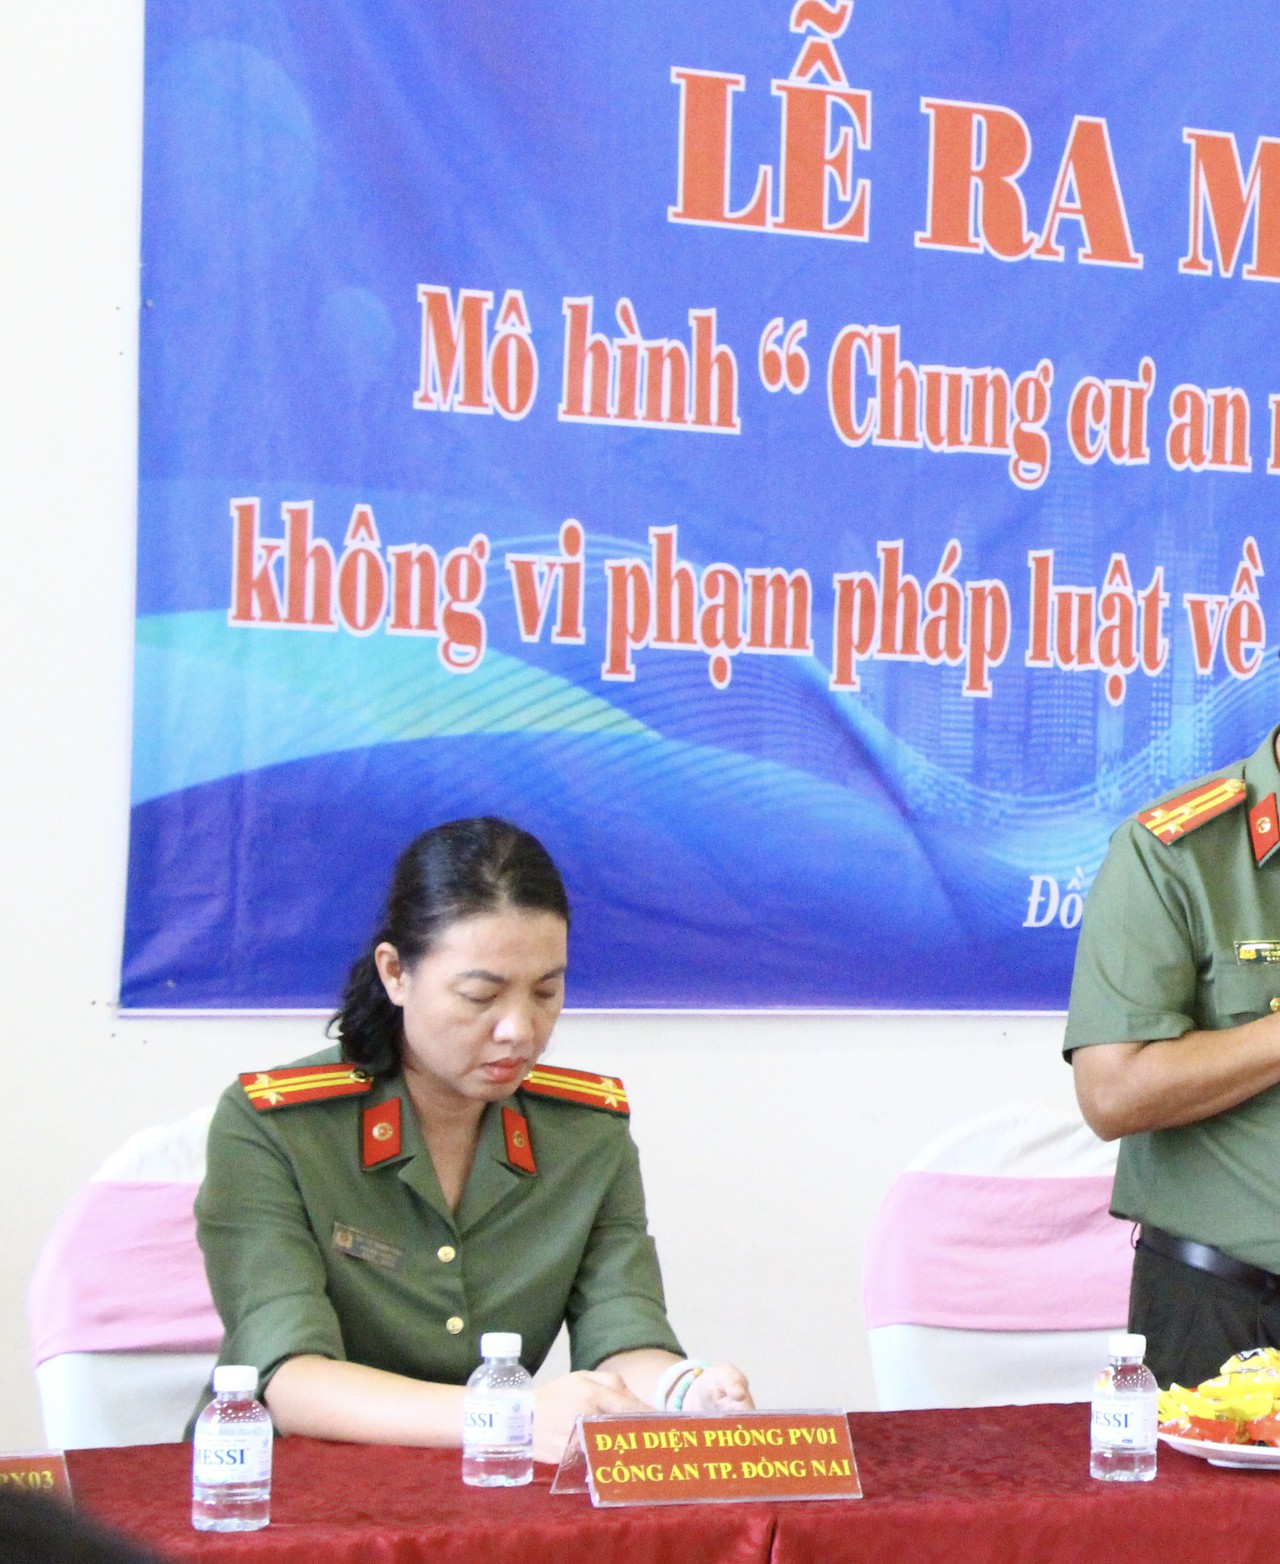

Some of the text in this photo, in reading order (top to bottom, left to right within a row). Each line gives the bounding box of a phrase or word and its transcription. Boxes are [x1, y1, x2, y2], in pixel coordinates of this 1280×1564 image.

[667, 0, 871, 242] LỄ
[914, 97, 1143, 269] RA
[413, 284, 538, 420] Mô
[558, 296, 741, 434] hình
[828, 323, 1053, 489] Chung
[1067, 356, 1156, 464] cư
[1166, 384, 1251, 473] an
[228, 497, 490, 673] không
[506, 519, 585, 644] vi
[601, 525, 813, 689] phạm
[830, 539, 1012, 697] pháp
[1026, 549, 1170, 706] luật
[1183, 536, 1266, 680] về
[1022, 866, 1083, 929] Đồ
[463, 1411, 494, 1428] ESSI
[596, 1424, 838, 1454] ĐẠI DIỆN PHÒNG PV01
[1092, 1410, 1129, 1429] ESSI
[595, 1456, 852, 1484] CÔNG AN TP. ĐỒNG NAI
